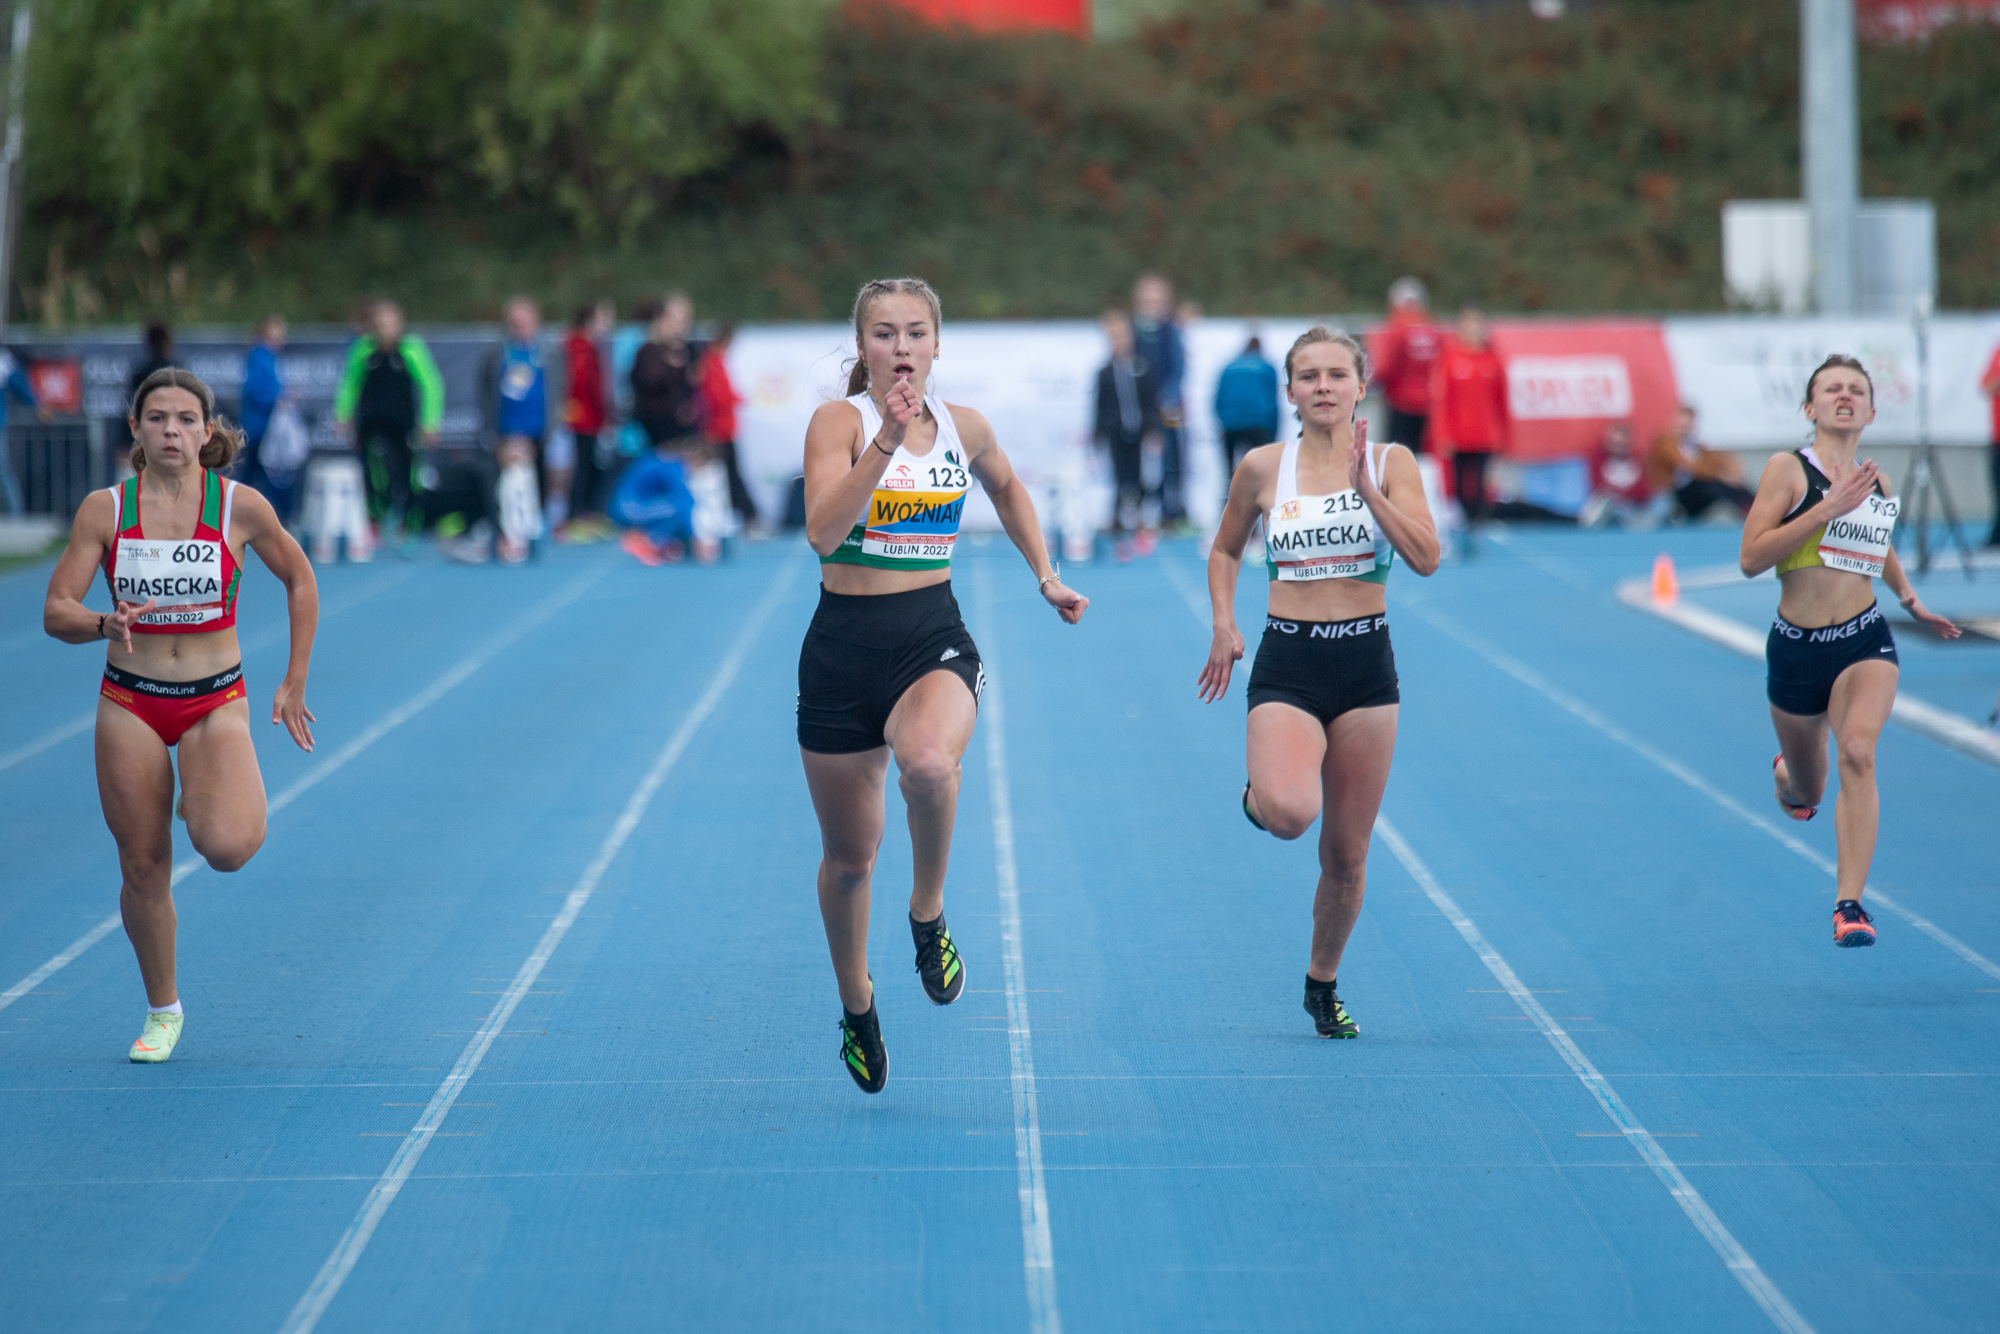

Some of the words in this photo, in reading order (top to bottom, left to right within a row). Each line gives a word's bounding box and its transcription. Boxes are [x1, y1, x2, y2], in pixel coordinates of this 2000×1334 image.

[886, 480, 914, 488] ORLEN
[928, 467, 967, 488] 123
[876, 499, 963, 524] WOŹNIAK
[1323, 493, 1363, 515] 215
[1870, 498, 1897, 517] 903
[1272, 524, 1370, 552] MATECKA
[172, 544, 215, 563] 602
[883, 544, 919, 555] LUBLIN
[922, 545, 949, 556] 2022
[1294, 566, 1328, 578] LUBLIN
[1331, 563, 1359, 575] 2022
[1832, 556, 1864, 571] LUBLIN
[1866, 564, 1884, 575] 202
[118, 577, 218, 597] PIASECKA
[140, 614, 172, 624] UBLIN
[176, 612, 204, 623] 2022
[1309, 619, 1371, 639] NIKE
[1809, 620, 1858, 642] NIKE
